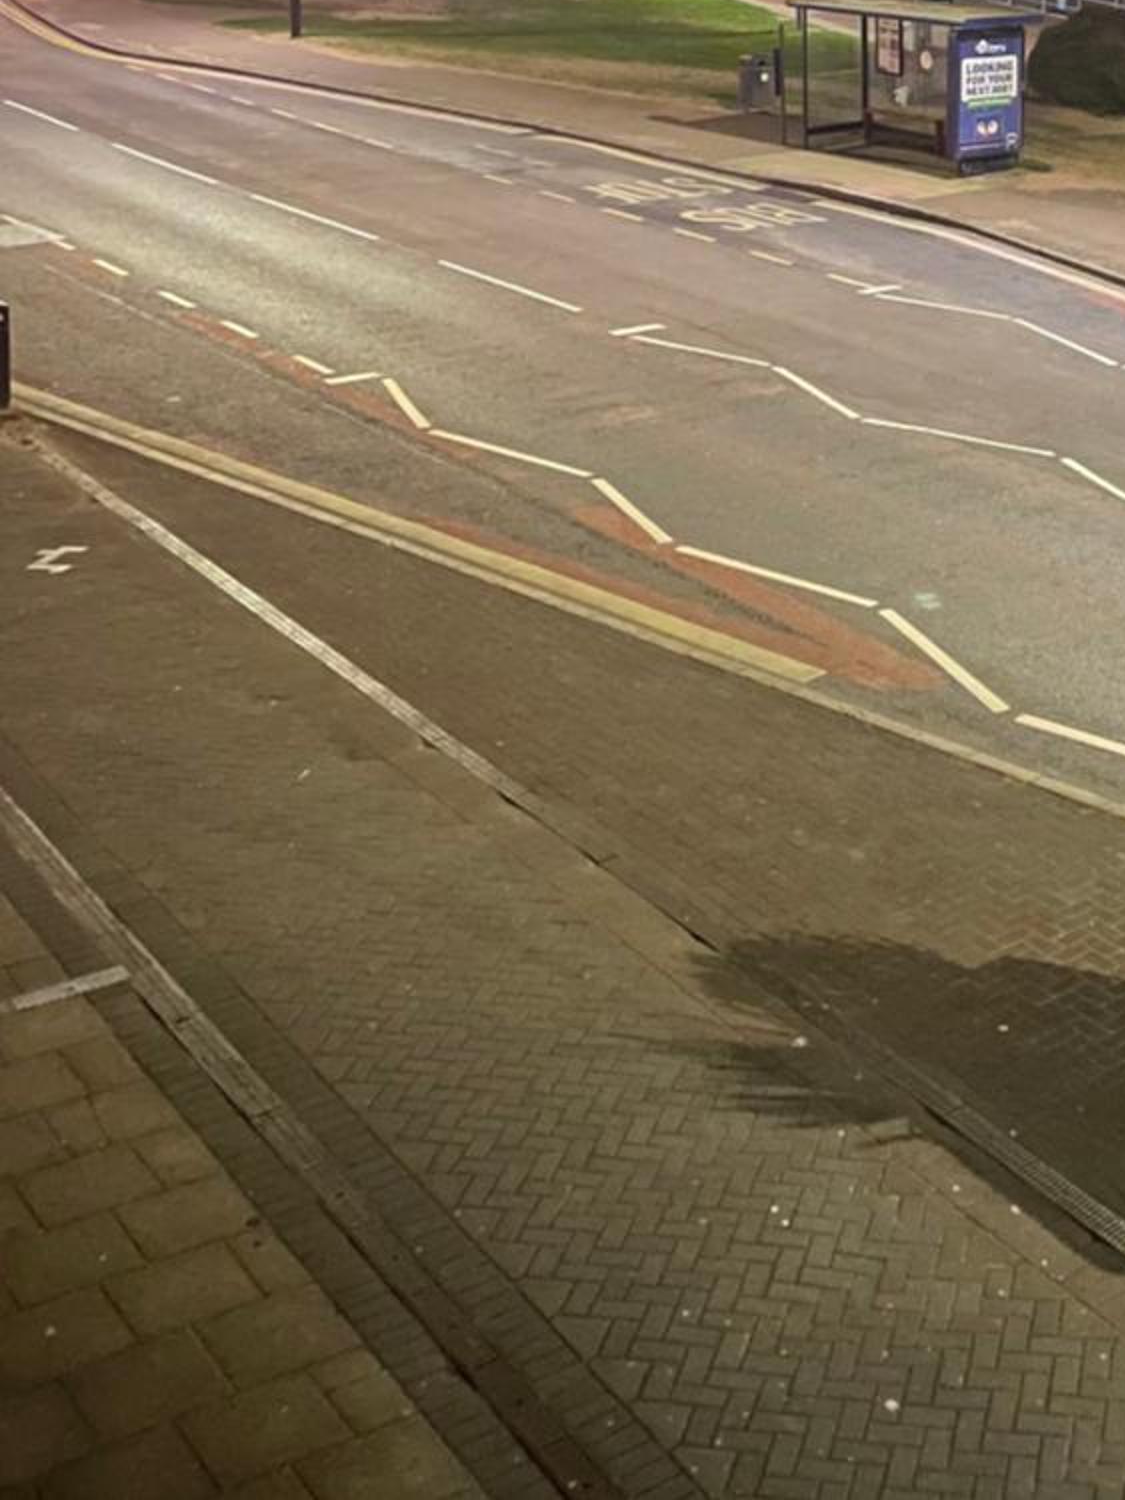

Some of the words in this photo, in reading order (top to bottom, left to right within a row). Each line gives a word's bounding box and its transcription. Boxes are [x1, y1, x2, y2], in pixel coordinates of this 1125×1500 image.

[966, 60, 1012, 74] LOOKING
[966, 76, 984, 84] FOR
[987, 74, 1012, 83] YOUR
[966, 87, 990, 96] NEXT
[678, 201, 829, 233] BUS
